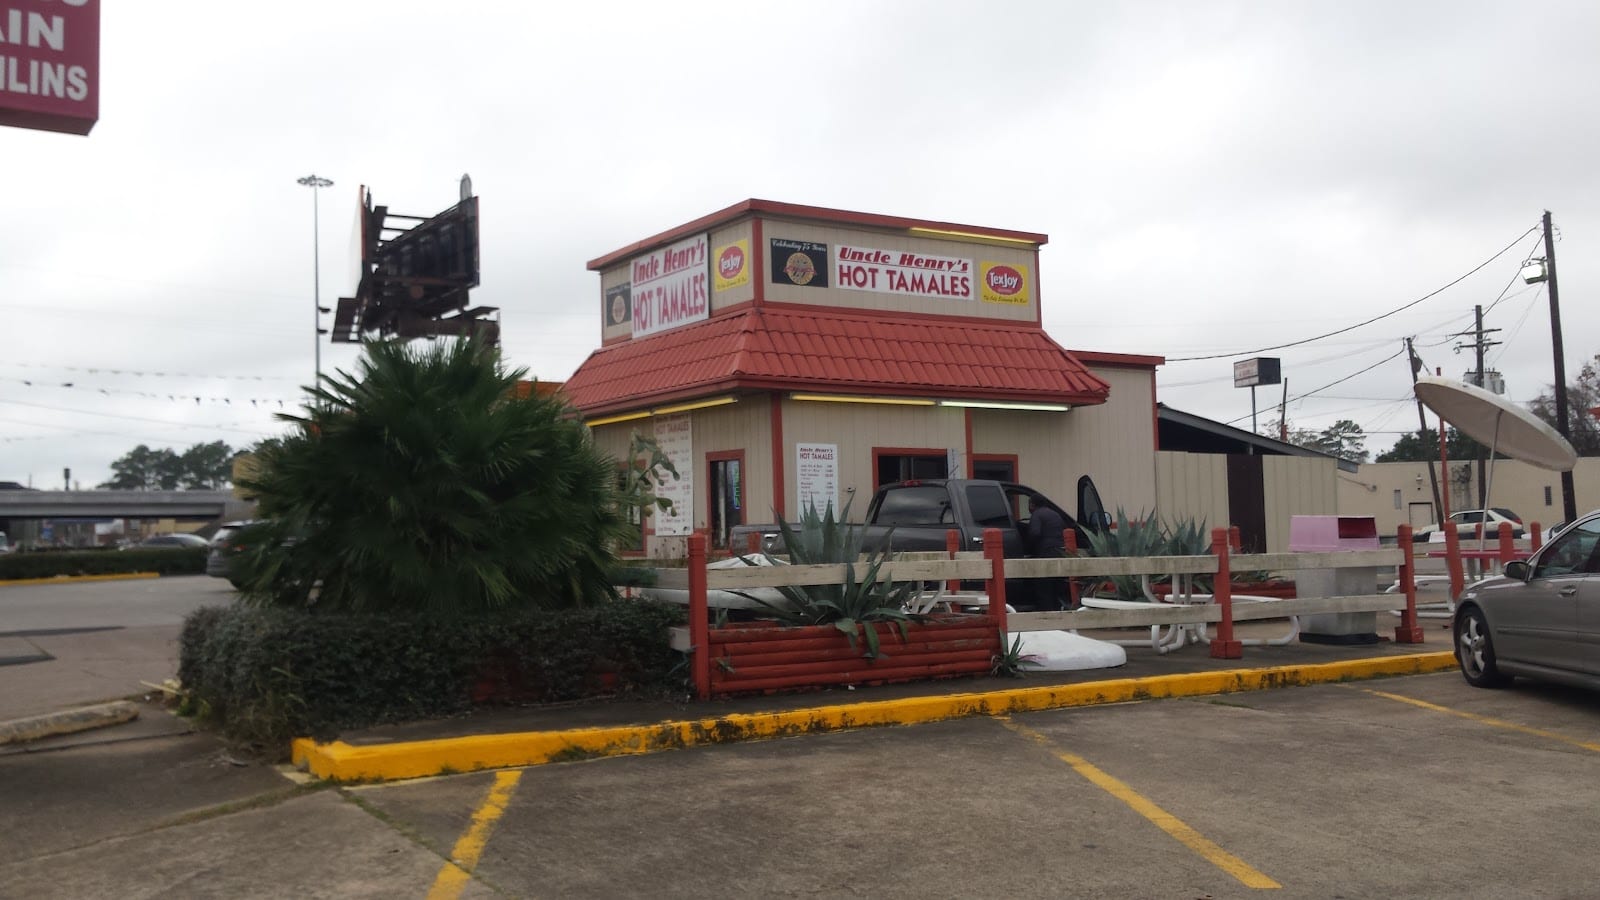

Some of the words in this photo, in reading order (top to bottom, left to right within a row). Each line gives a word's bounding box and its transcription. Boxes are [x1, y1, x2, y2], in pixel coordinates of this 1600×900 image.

[633, 256, 659, 284] Uncle
[664, 240, 705, 273] Henry's
[840, 247, 890, 264] Uncle
[899, 253, 968, 272] Henry's
[839, 264, 878, 288] HOT
[886, 270, 970, 297] TAMALES
[990, 272, 1018, 288] TexJoy
[633, 290, 654, 332] HOT
[657, 273, 706, 325] TAMALES
